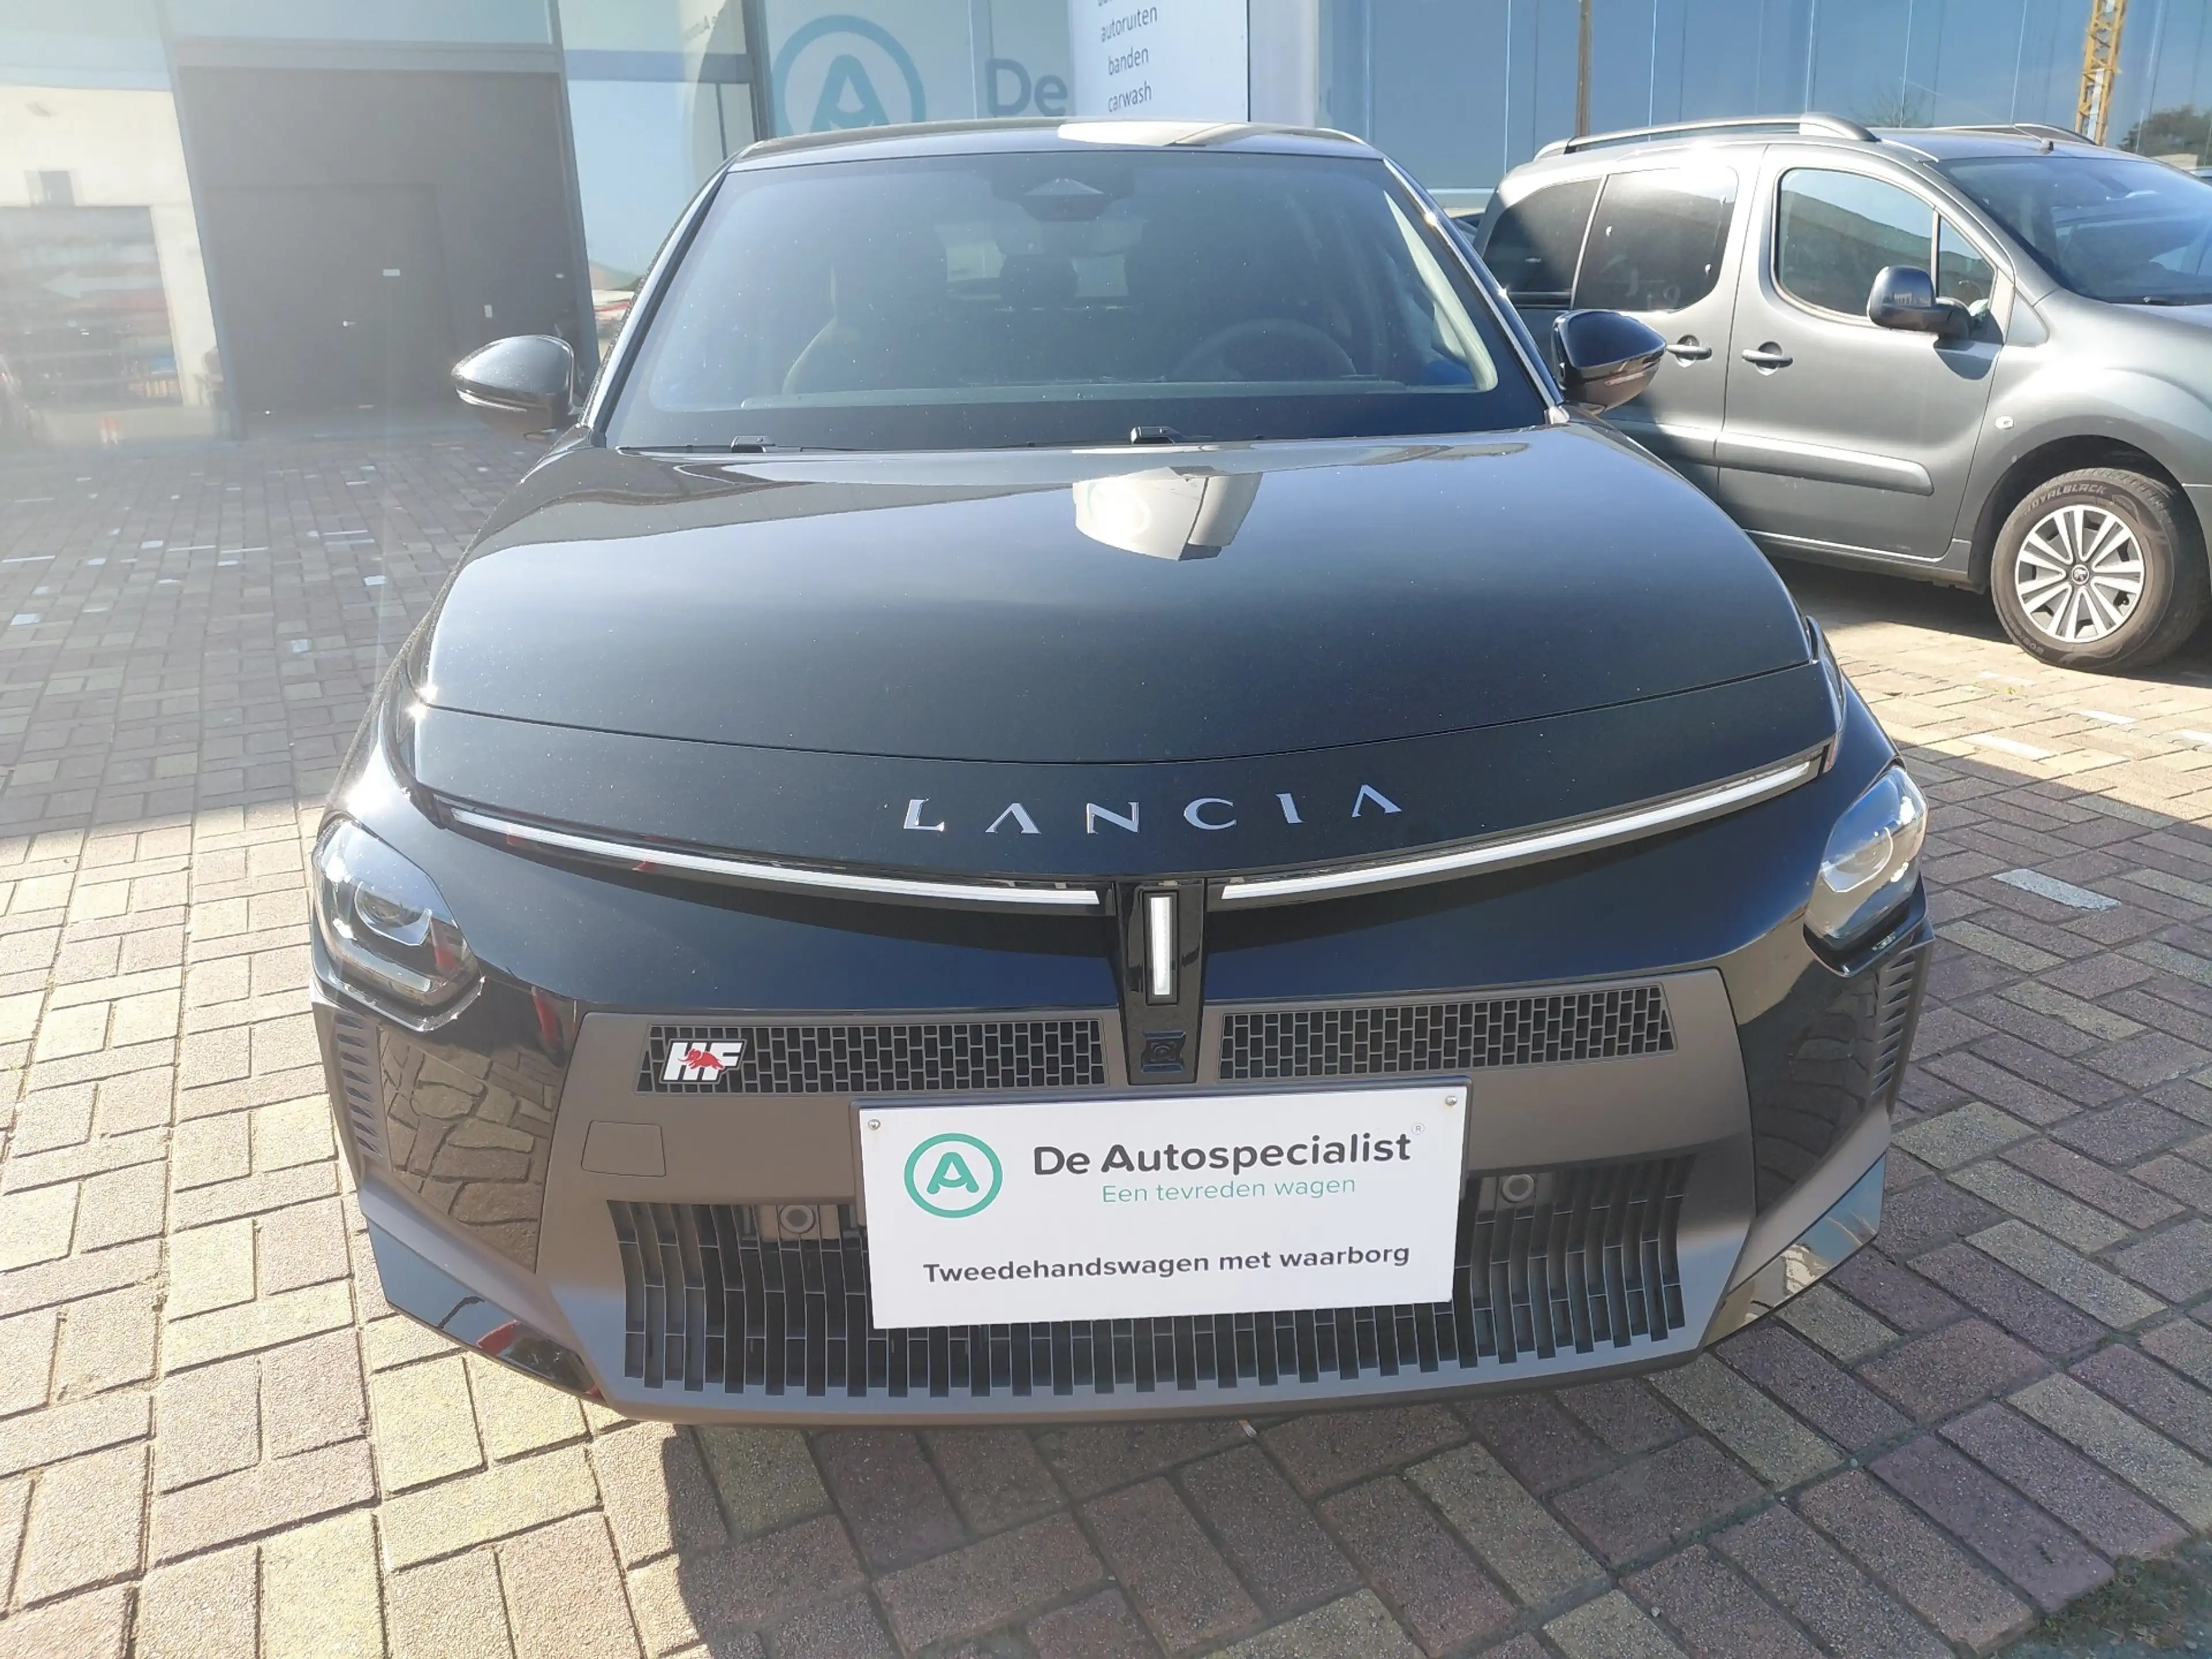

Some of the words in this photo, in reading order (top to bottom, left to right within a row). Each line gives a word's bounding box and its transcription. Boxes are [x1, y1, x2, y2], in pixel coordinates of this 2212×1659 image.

[1101, 6, 1158, 43] autoruiten
[1108, 46, 1149, 75] banden
[985, 58, 1068, 118] De
[1108, 80, 1152, 112] carwash
[902, 784, 1403, 834] LANCIA
[663, 1042, 743, 1081] HF
[1034, 1146, 1090, 1175] De
[1101, 1132, 1411, 1176] Autospecialist
[1101, 1184, 1149, 1203] Een
[1157, 1179, 1266, 1200] tevreden
[1274, 1176, 1356, 1200] wagen
[923, 1257, 1209, 1282] Tweedehandswagen
[1219, 1252, 1271, 1270] met
[1279, 1246, 1410, 1266] waarborg
